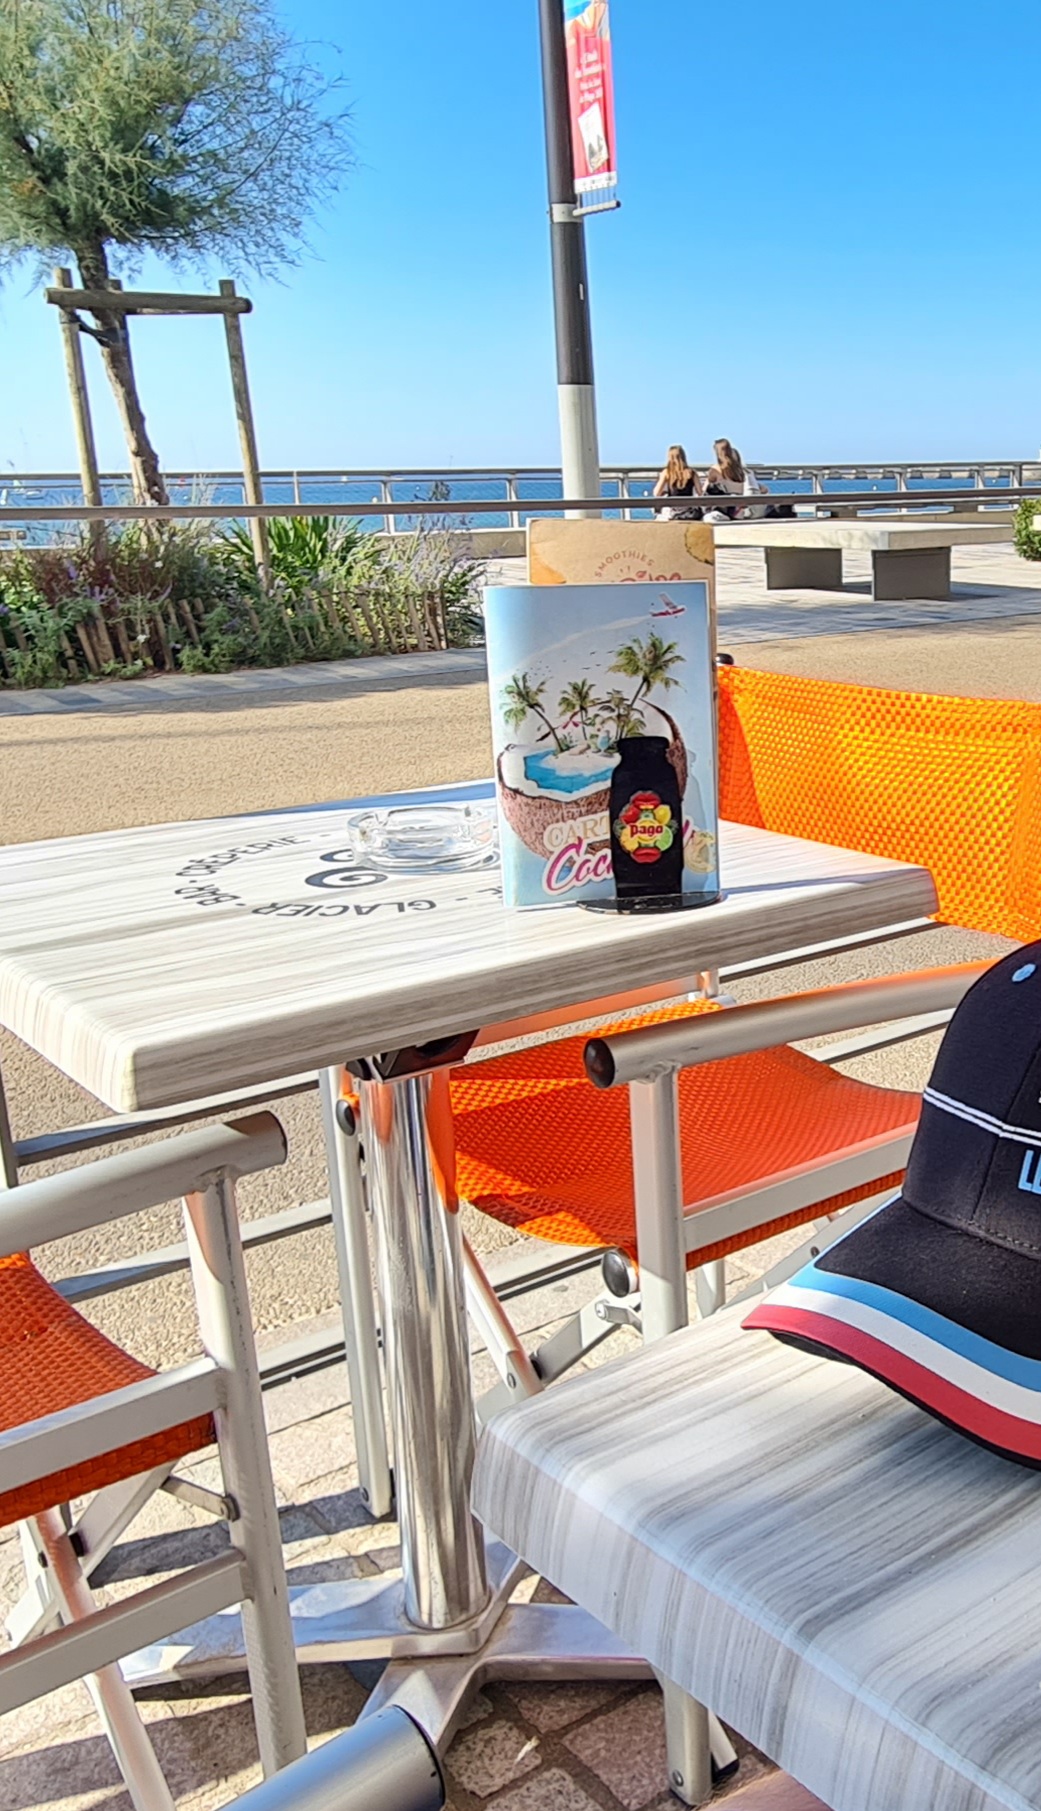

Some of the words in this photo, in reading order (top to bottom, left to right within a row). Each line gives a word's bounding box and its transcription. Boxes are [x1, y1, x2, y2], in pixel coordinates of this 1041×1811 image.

[595, 550, 655, 577] SMOOTHIES
[547, 816, 610, 848] CART
[174, 884, 241, 906] BAR
[251, 899, 437, 917] GLACIER
